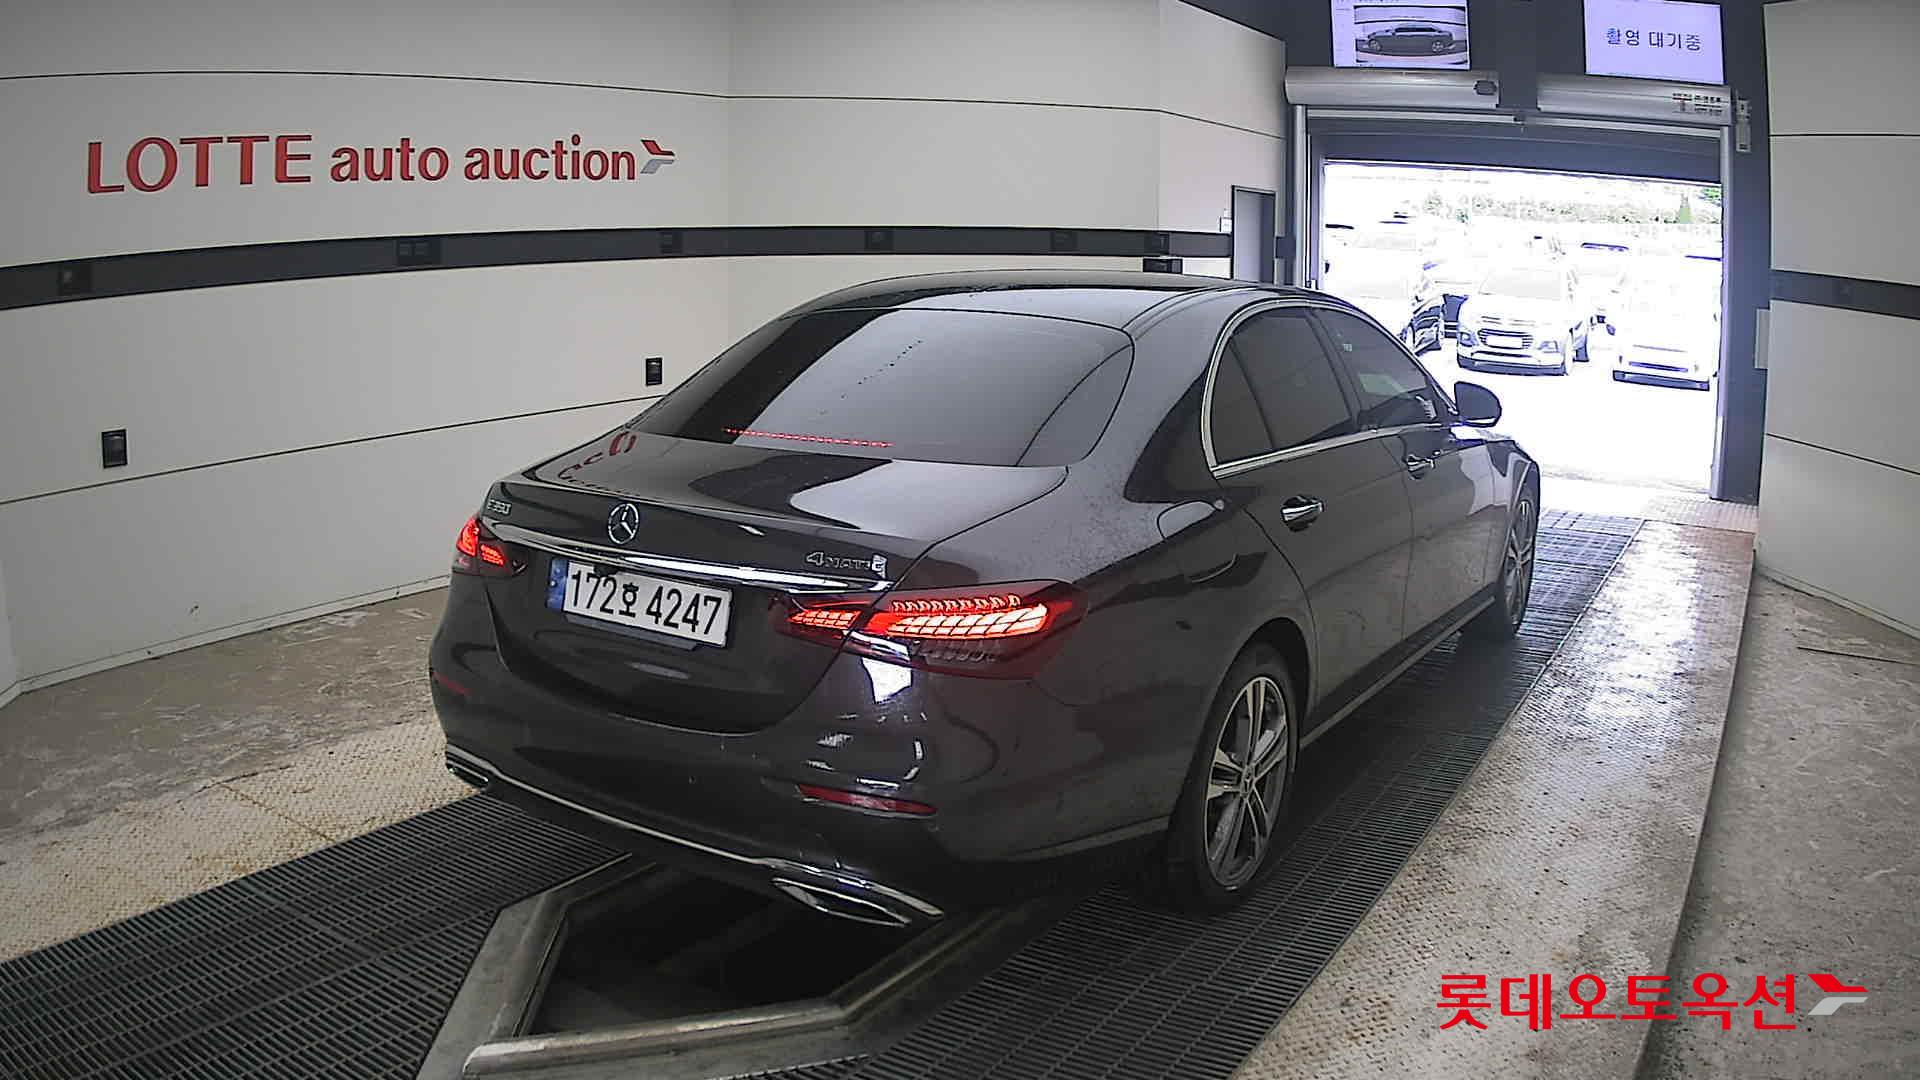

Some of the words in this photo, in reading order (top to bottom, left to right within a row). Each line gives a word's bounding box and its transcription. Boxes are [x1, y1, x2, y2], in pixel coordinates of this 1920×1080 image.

[1648, 31, 1701, 51] 대기중
[87, 134, 313, 194] LOTTE
[330, 137, 449, 182] auto
[463, 133, 636, 181] auction
[645, 585, 723, 635] 4247
